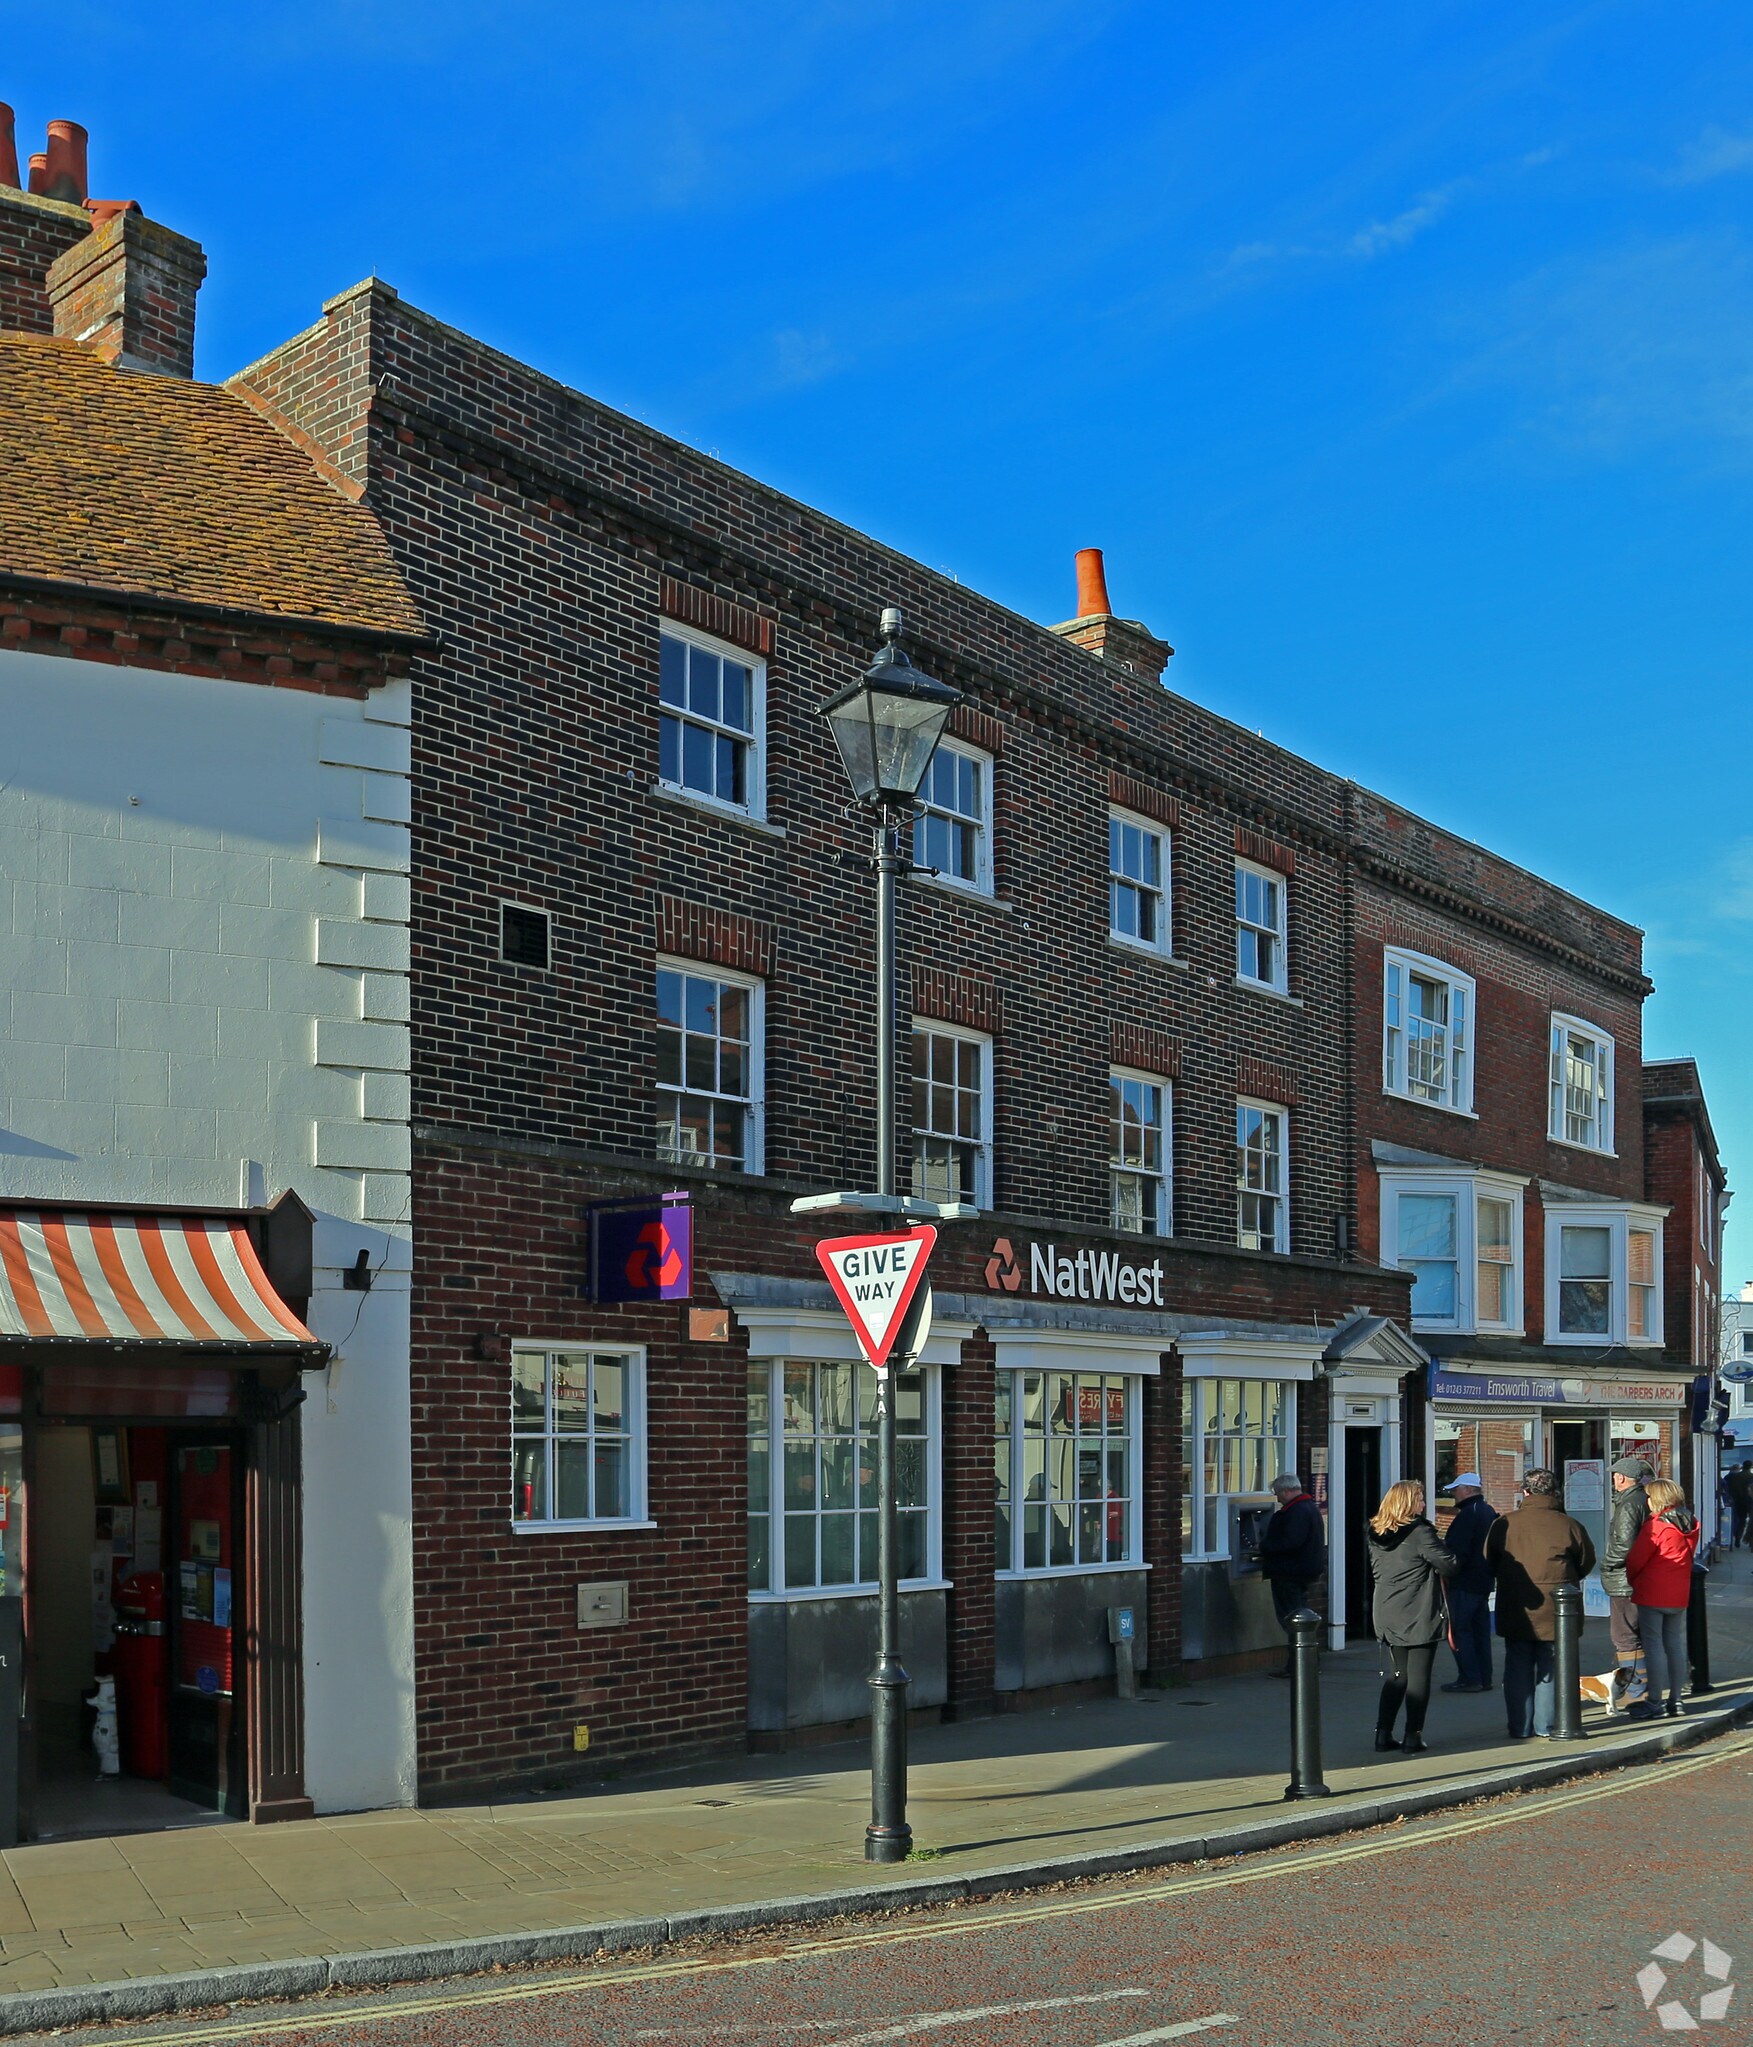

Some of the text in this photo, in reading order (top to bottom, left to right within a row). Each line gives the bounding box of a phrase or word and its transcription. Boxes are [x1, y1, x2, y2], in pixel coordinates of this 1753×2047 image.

[842, 1246, 907, 1278] GIVE
[1030, 1241, 1164, 1306] NatWest
[855, 1281, 895, 1302] WAY
[877, 1383, 886, 1397] 4
[1436, 1380, 1556, 1398] Tel: 01243 377211 Emsworth Travel
[1618, 1385, 1653, 1400] BARBERS
[1654, 1387, 1675, 1400] ARCH
[877, 1400, 887, 1414] A
[1121, 1618, 1131, 1629] SV
